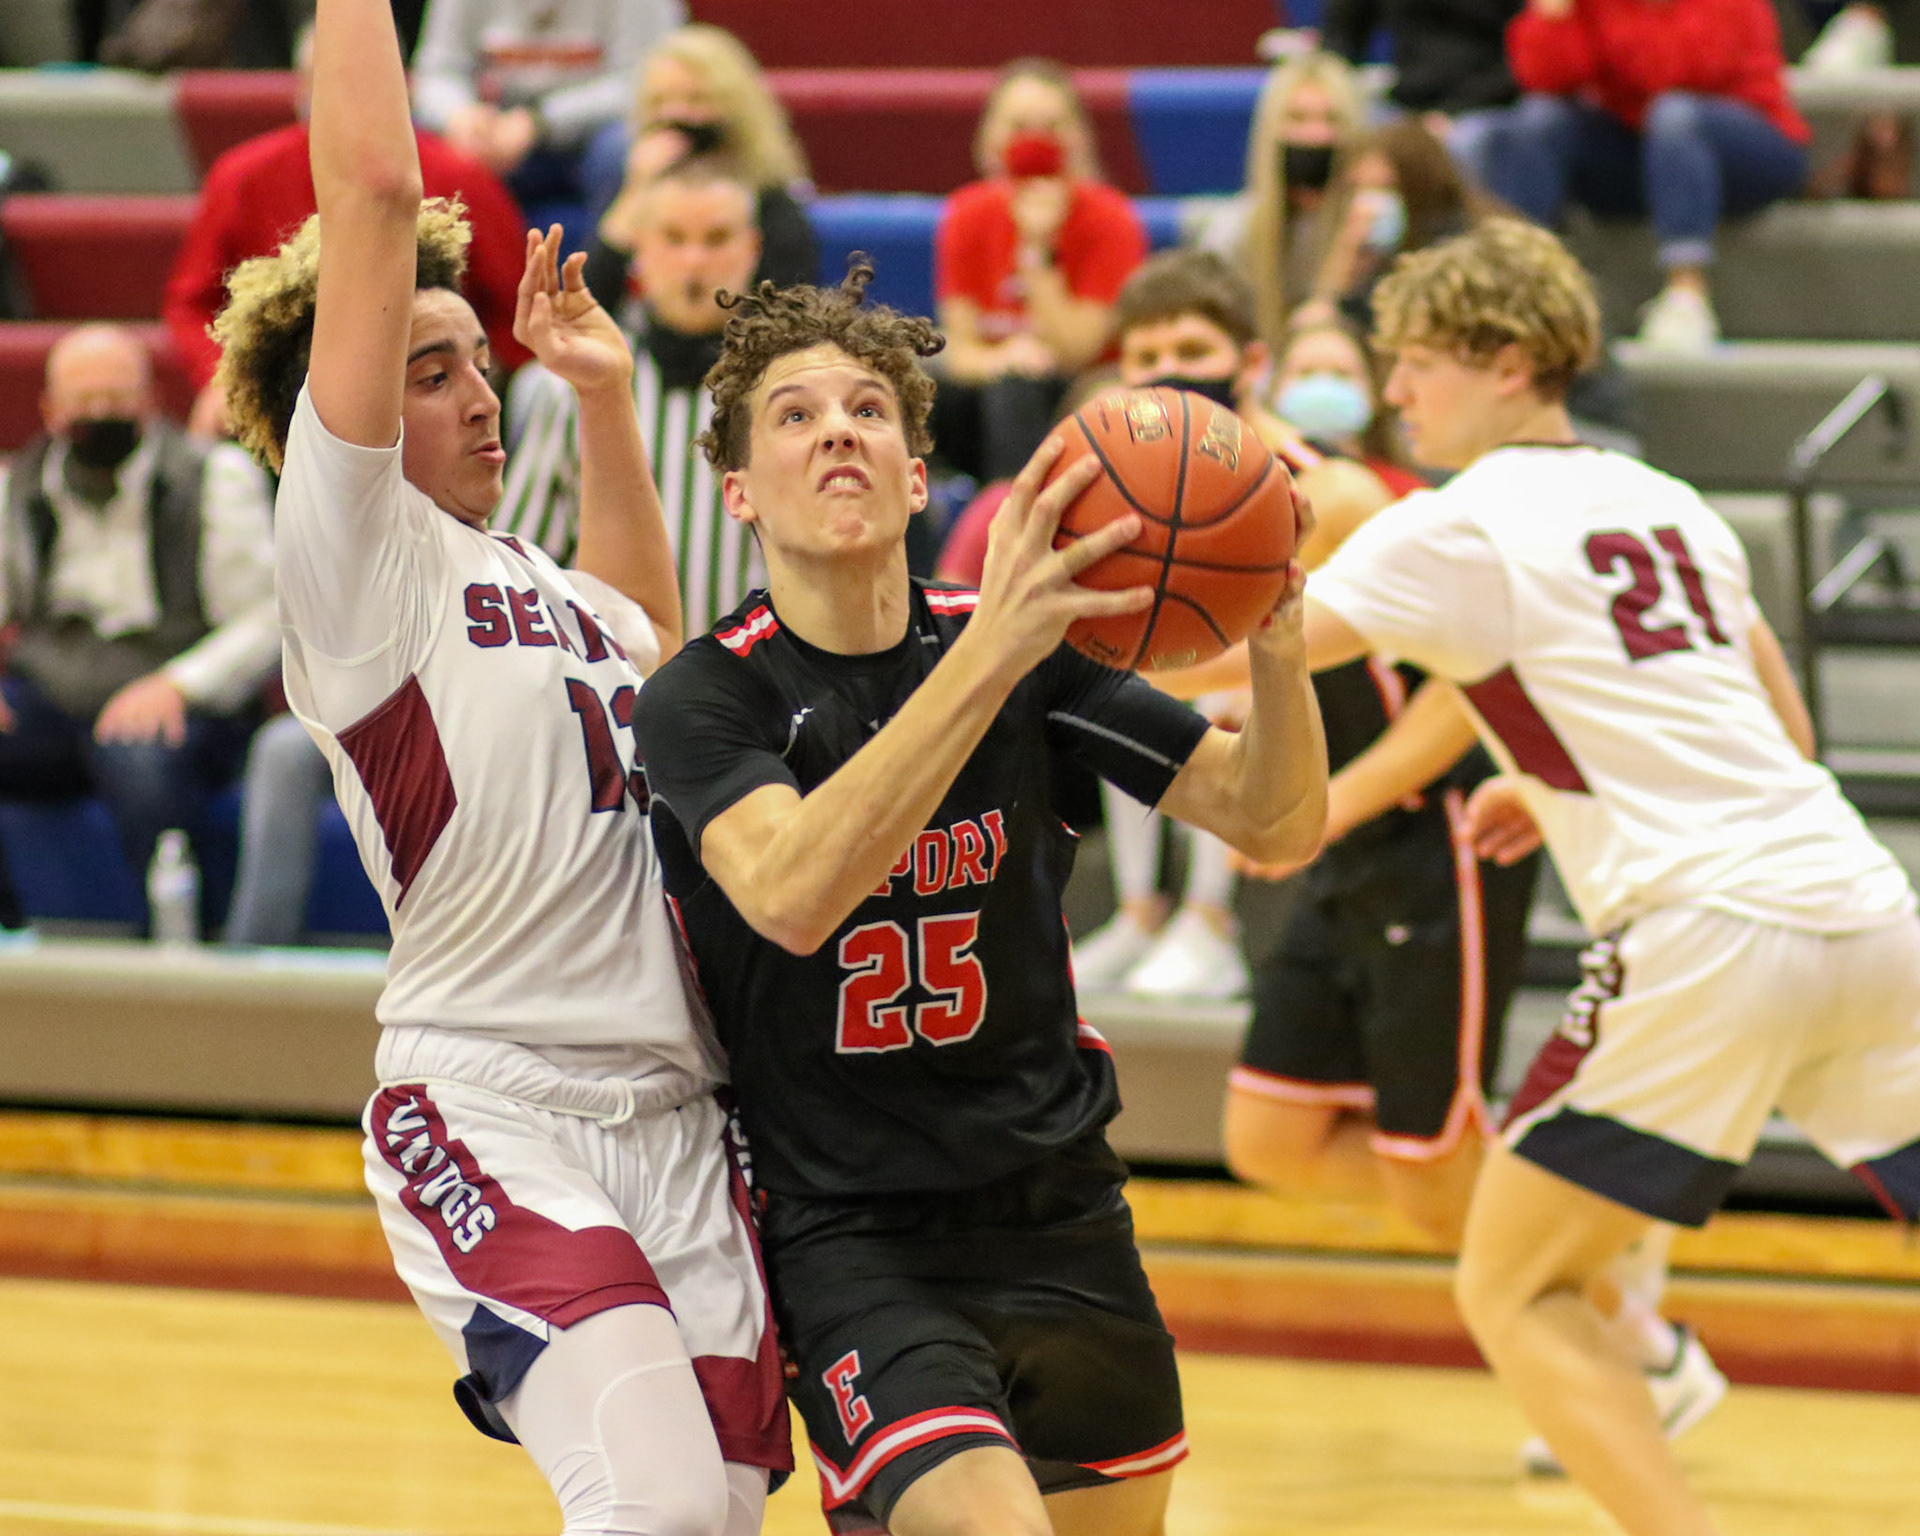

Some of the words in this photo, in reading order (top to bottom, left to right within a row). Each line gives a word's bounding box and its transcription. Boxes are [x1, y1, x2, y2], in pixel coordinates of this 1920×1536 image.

[1584, 526, 1731, 661] 21
[835, 910, 987, 1054] 25
[822, 1349, 874, 1445] E
